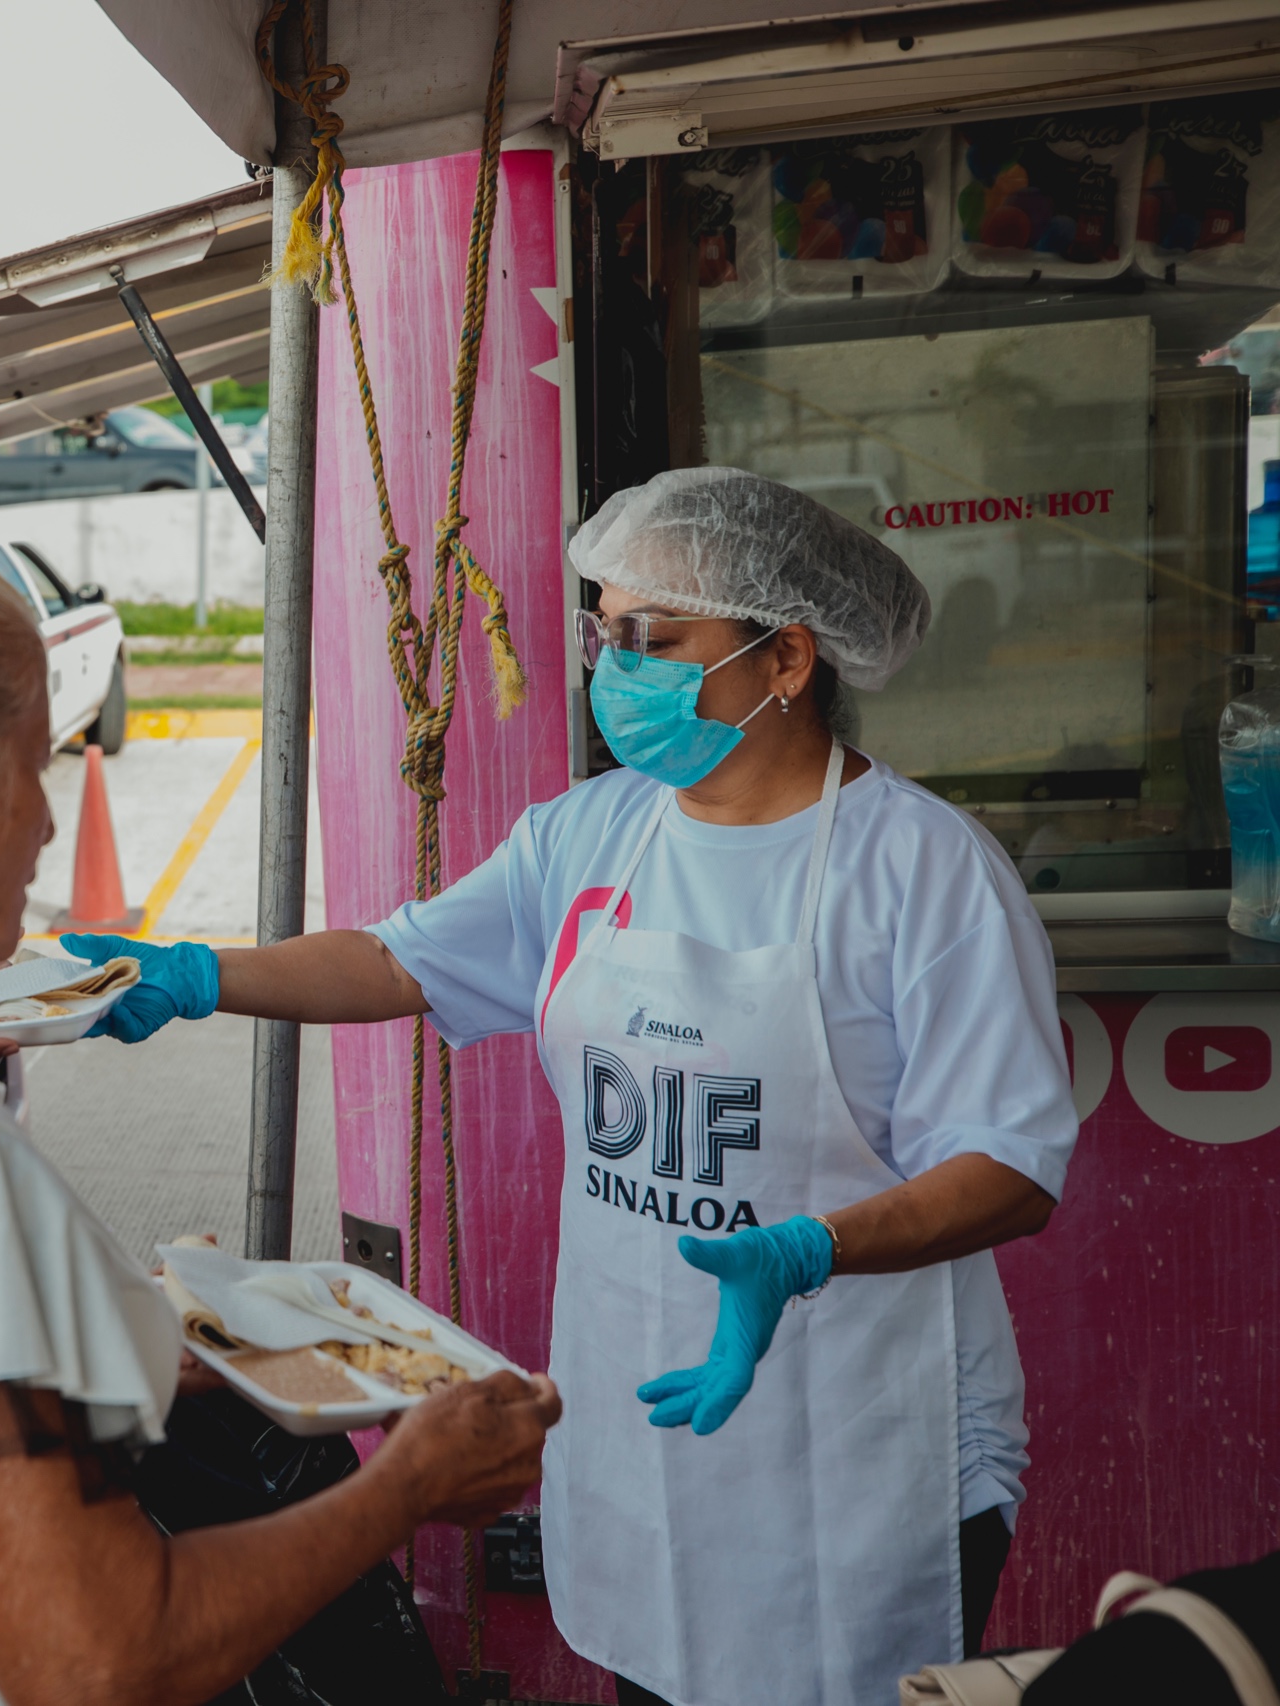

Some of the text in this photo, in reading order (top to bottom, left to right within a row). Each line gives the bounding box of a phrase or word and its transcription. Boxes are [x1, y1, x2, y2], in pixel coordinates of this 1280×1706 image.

[881, 153, 915, 183] 25
[884, 489, 1114, 530] CAUTION: HOT
[646, 1020, 704, 1042] SINALOA
[583, 1044, 762, 1187] DIF
[586, 1163, 761, 1233] SINALOA
